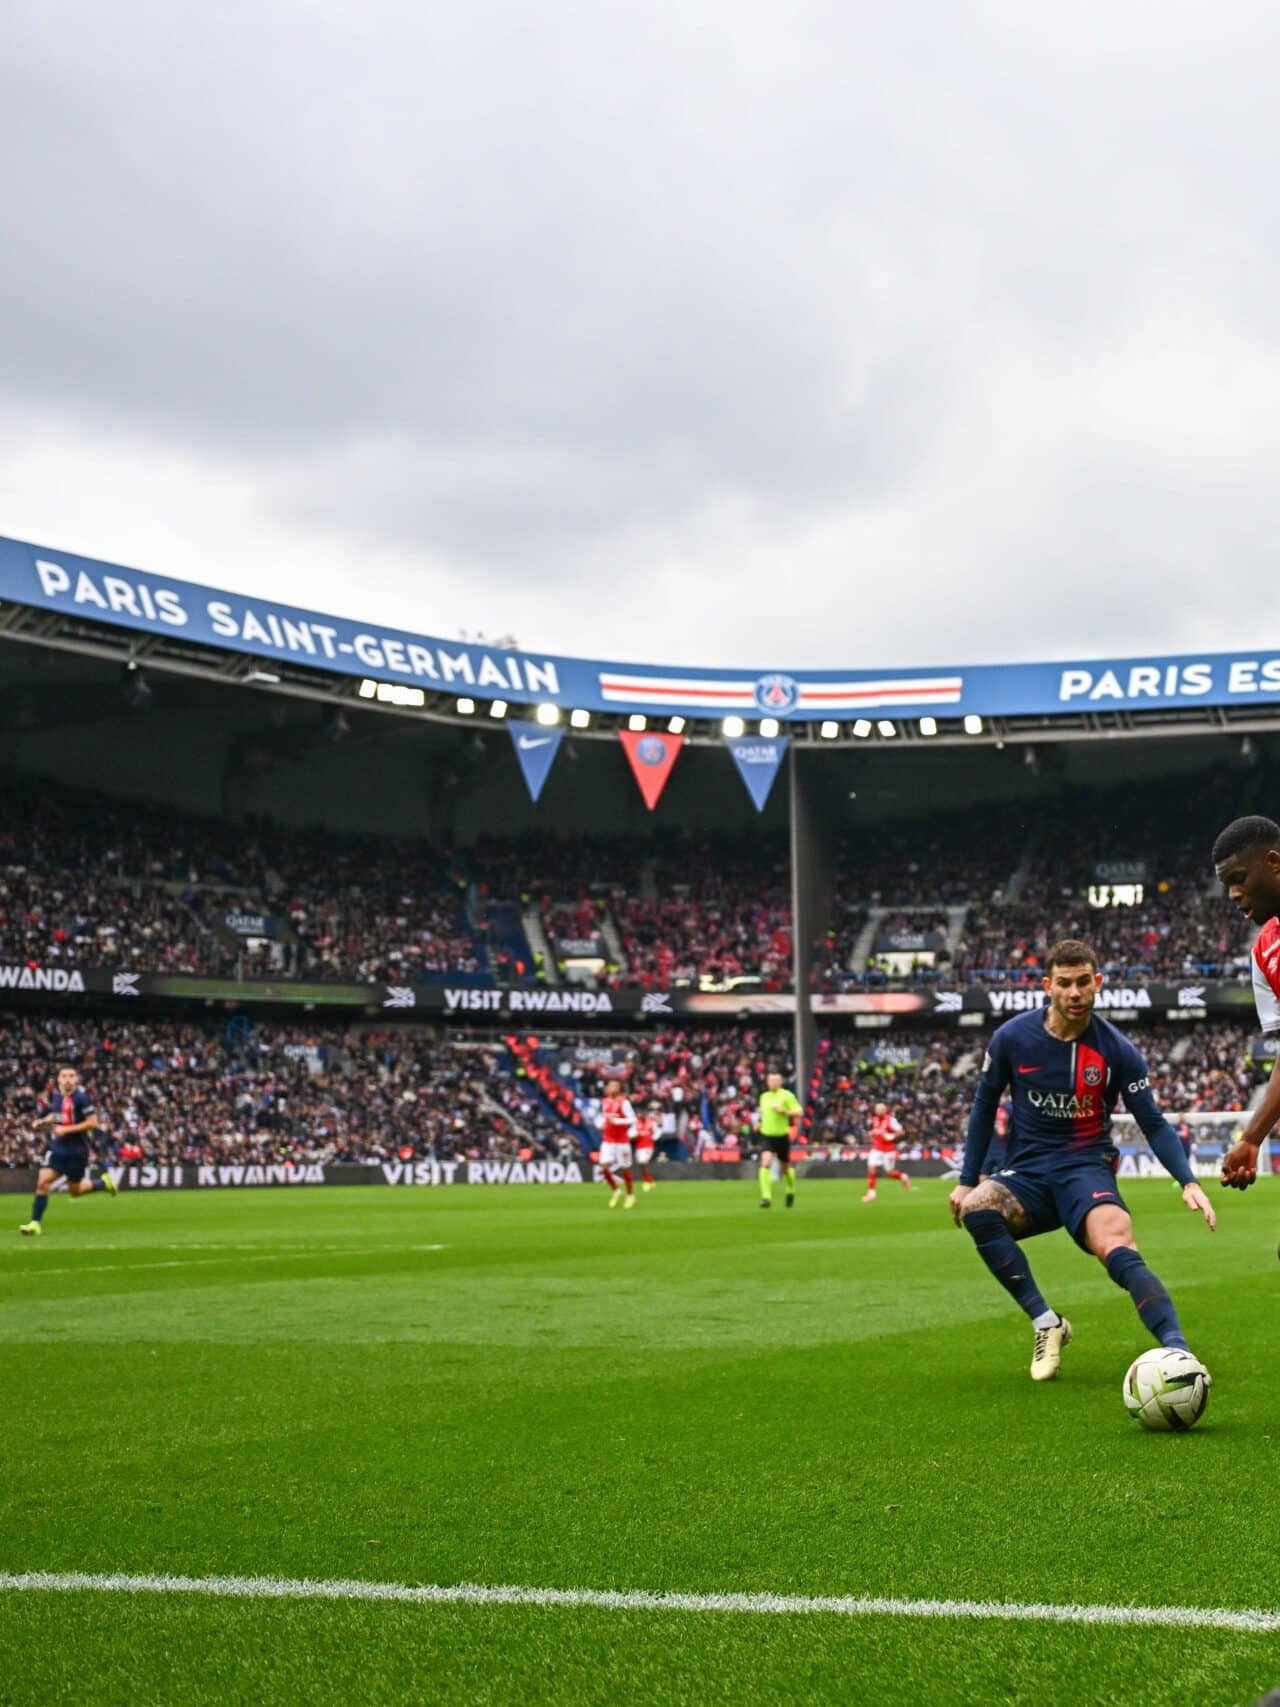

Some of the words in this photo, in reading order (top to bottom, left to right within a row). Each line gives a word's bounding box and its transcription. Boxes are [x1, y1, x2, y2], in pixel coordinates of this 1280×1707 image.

[34, 559, 188, 627] PARIS
[208, 601, 560, 695] SAINT-GERMAIN
[1059, 663, 1213, 701] PARIS
[0, 966, 86, 992] WANDA
[444, 989, 503, 1010] VISIT
[509, 990, 613, 1012] RWANDA
[989, 991, 1045, 1011] VISIT
[1093, 988, 1152, 1009] ANDA
[1028, 1089, 1093, 1109] QATAR
[1041, 1109, 1094, 1118] AIRWAYS
[383, 1162, 458, 1186] VISIT
[468, 1161, 582, 1185] RWANDA
